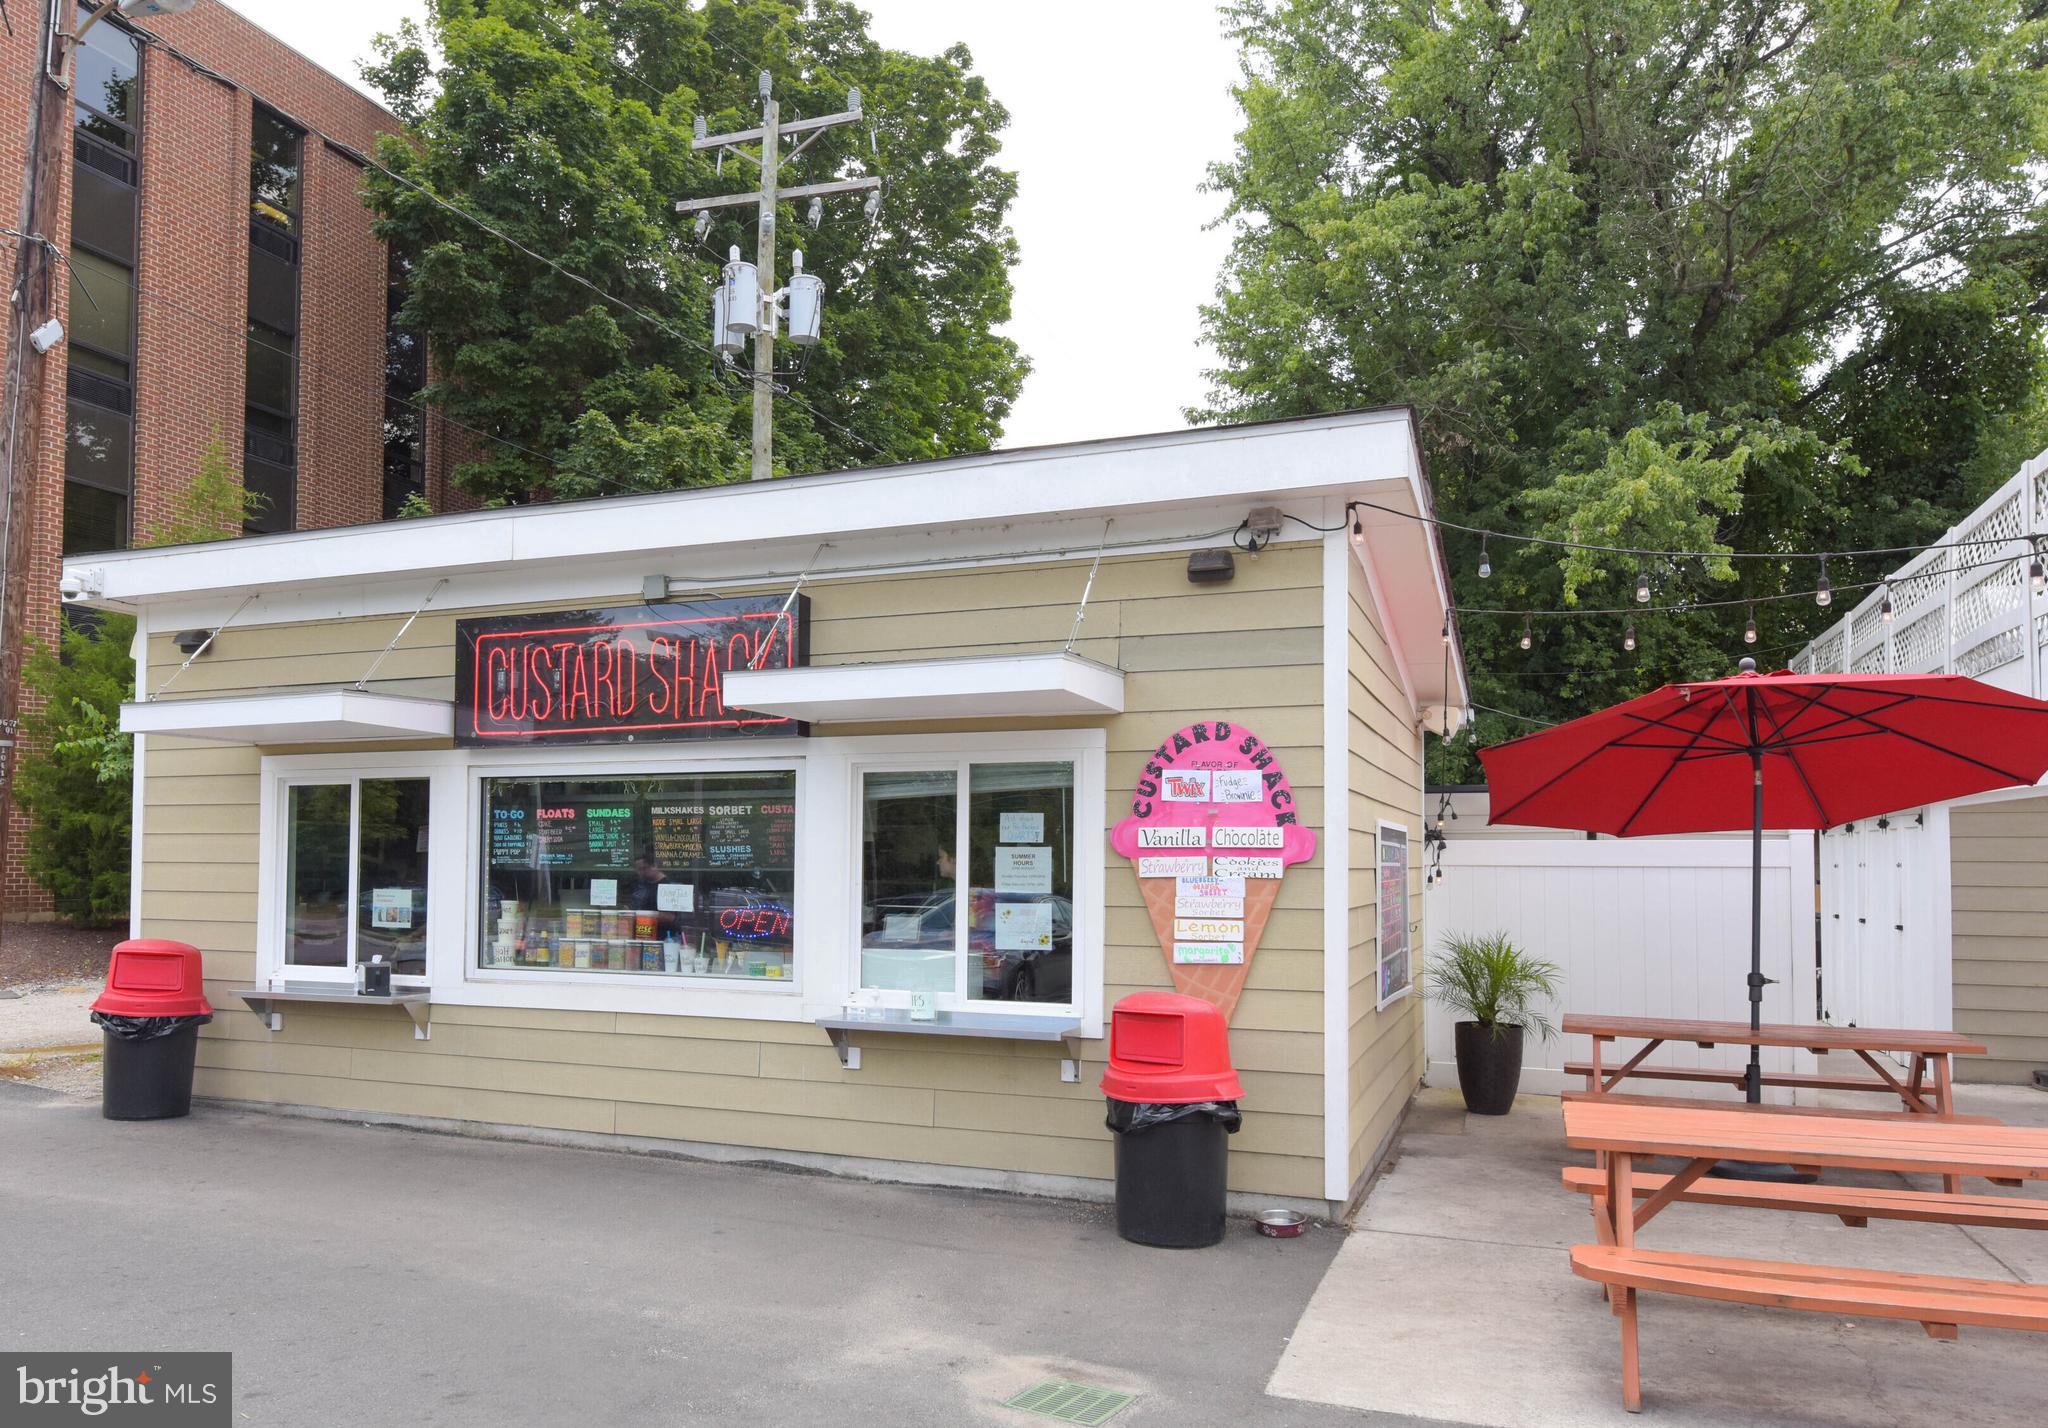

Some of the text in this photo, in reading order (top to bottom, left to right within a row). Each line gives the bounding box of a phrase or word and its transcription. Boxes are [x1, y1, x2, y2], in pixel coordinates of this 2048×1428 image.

[488, 639, 636, 720] CUSTARD
[1191, 760, 1223, 768] FLAVOR
[1132, 721, 1296, 827] CUSTARD SHACK
[1218, 776, 1242, 790] Fudge
[1224, 789, 1256, 801] Brownie
[494, 809, 524, 819] TO-GO
[536, 808, 576, 819] FLOATS
[587, 808, 631, 818] SUNDAES
[651, 806, 704, 815] MILKSHAKES
[708, 805, 753, 816] SORBET
[1142, 828, 1202, 846] Vanilla
[1215, 828, 1280, 846] Chocolate
[709, 845, 752, 854] SLUSHIES
[1141, 858, 1203, 876] Strawberry
[1214, 856, 1279, 866] Cookies
[1214, 868, 1277, 878] Cream
[1178, 898, 1241, 911] Strawberry
[720, 908, 791, 935] OPEN
[1177, 919, 1240, 933] Lemon
